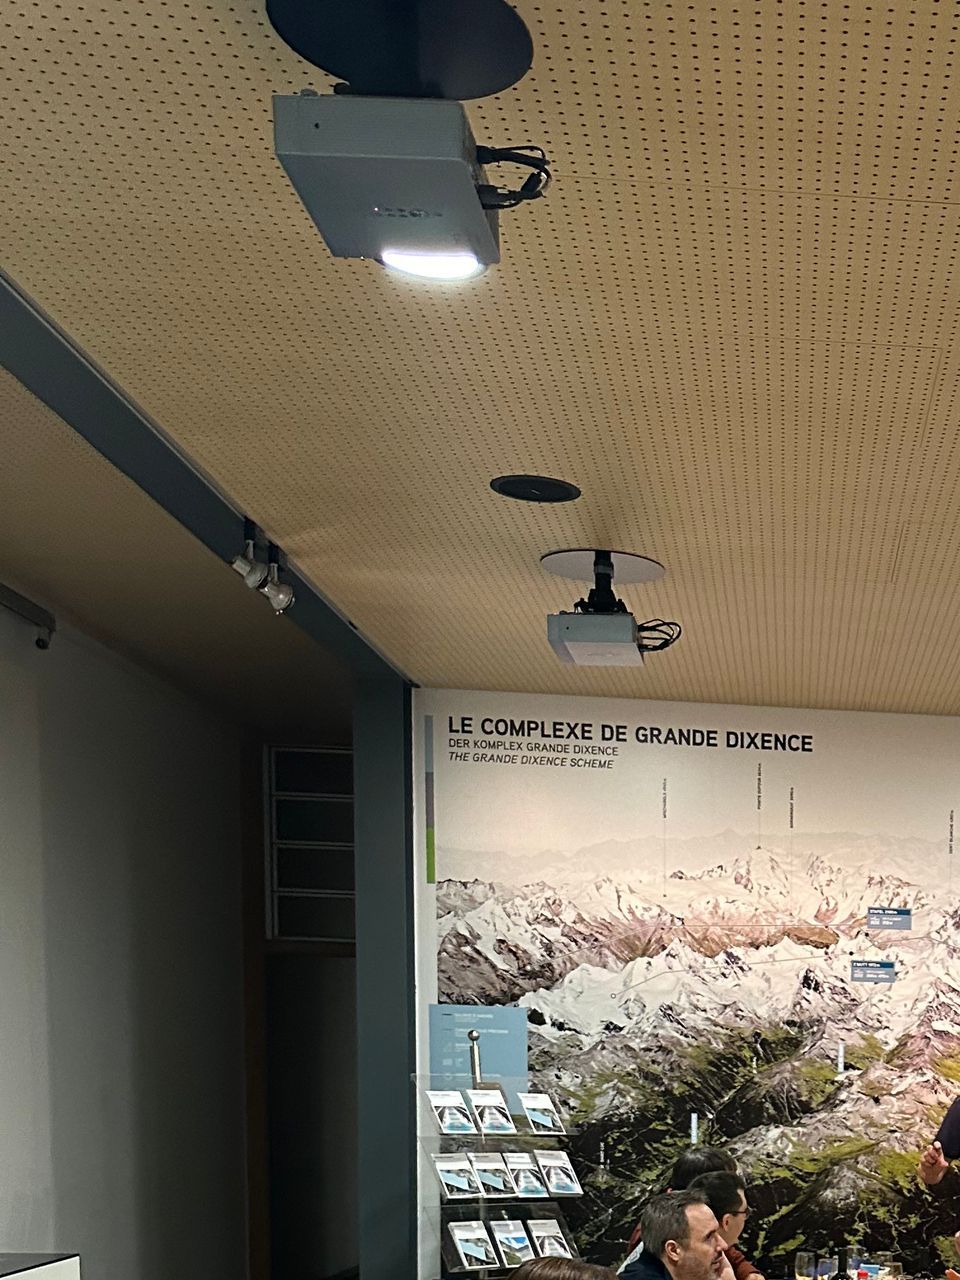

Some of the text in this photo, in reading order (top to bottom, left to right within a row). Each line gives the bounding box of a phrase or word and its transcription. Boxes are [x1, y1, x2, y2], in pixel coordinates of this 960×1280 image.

[448, 716, 813, 752] LE COMPLEXE DE GRANDE DIXENCE
[448, 738, 619, 756] DER KOMPLEX GRANDE DIXENCE
[449, 751, 614, 769] THE GRANDE DIXENCE SCHEME
